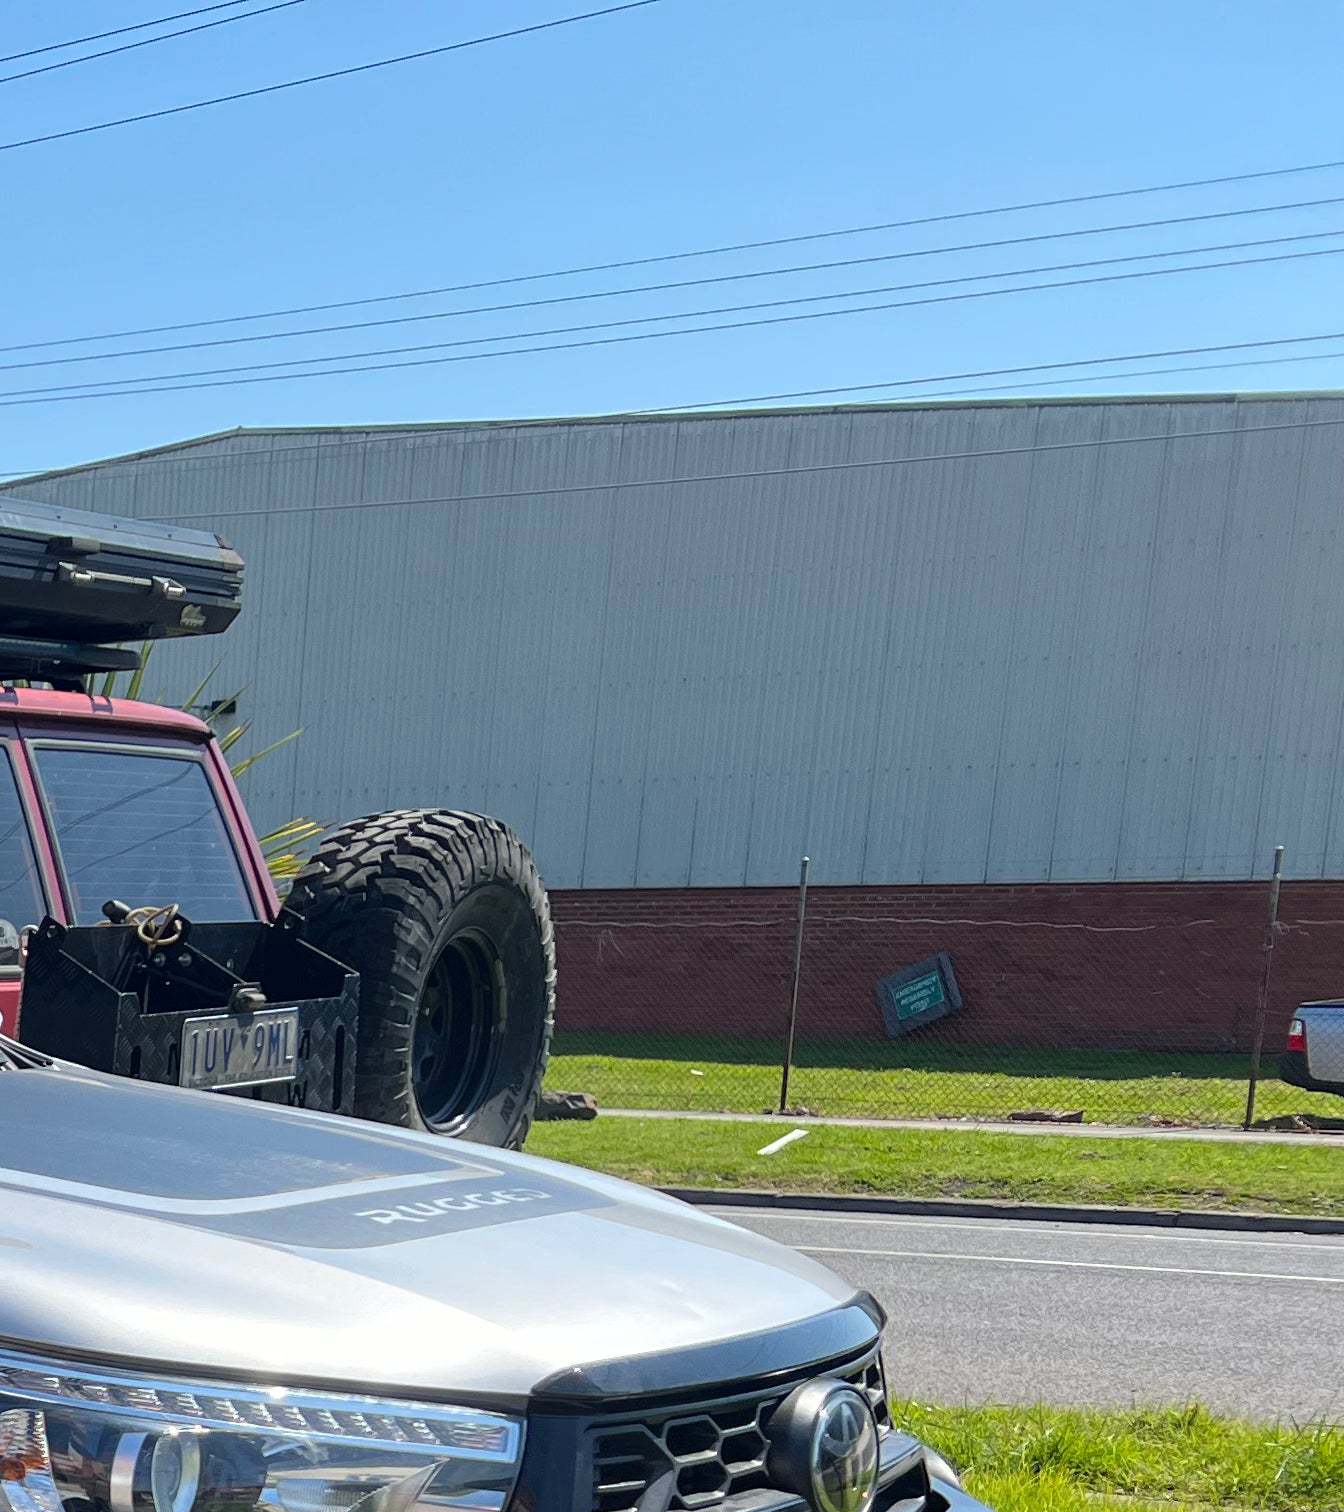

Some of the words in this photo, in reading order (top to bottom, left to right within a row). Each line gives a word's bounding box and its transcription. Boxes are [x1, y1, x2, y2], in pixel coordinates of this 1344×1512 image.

[192, 1027, 235, 1076] 1UV
[252, 1020, 295, 1068] 9ML
[353, 1188, 553, 1225] RUGGED
